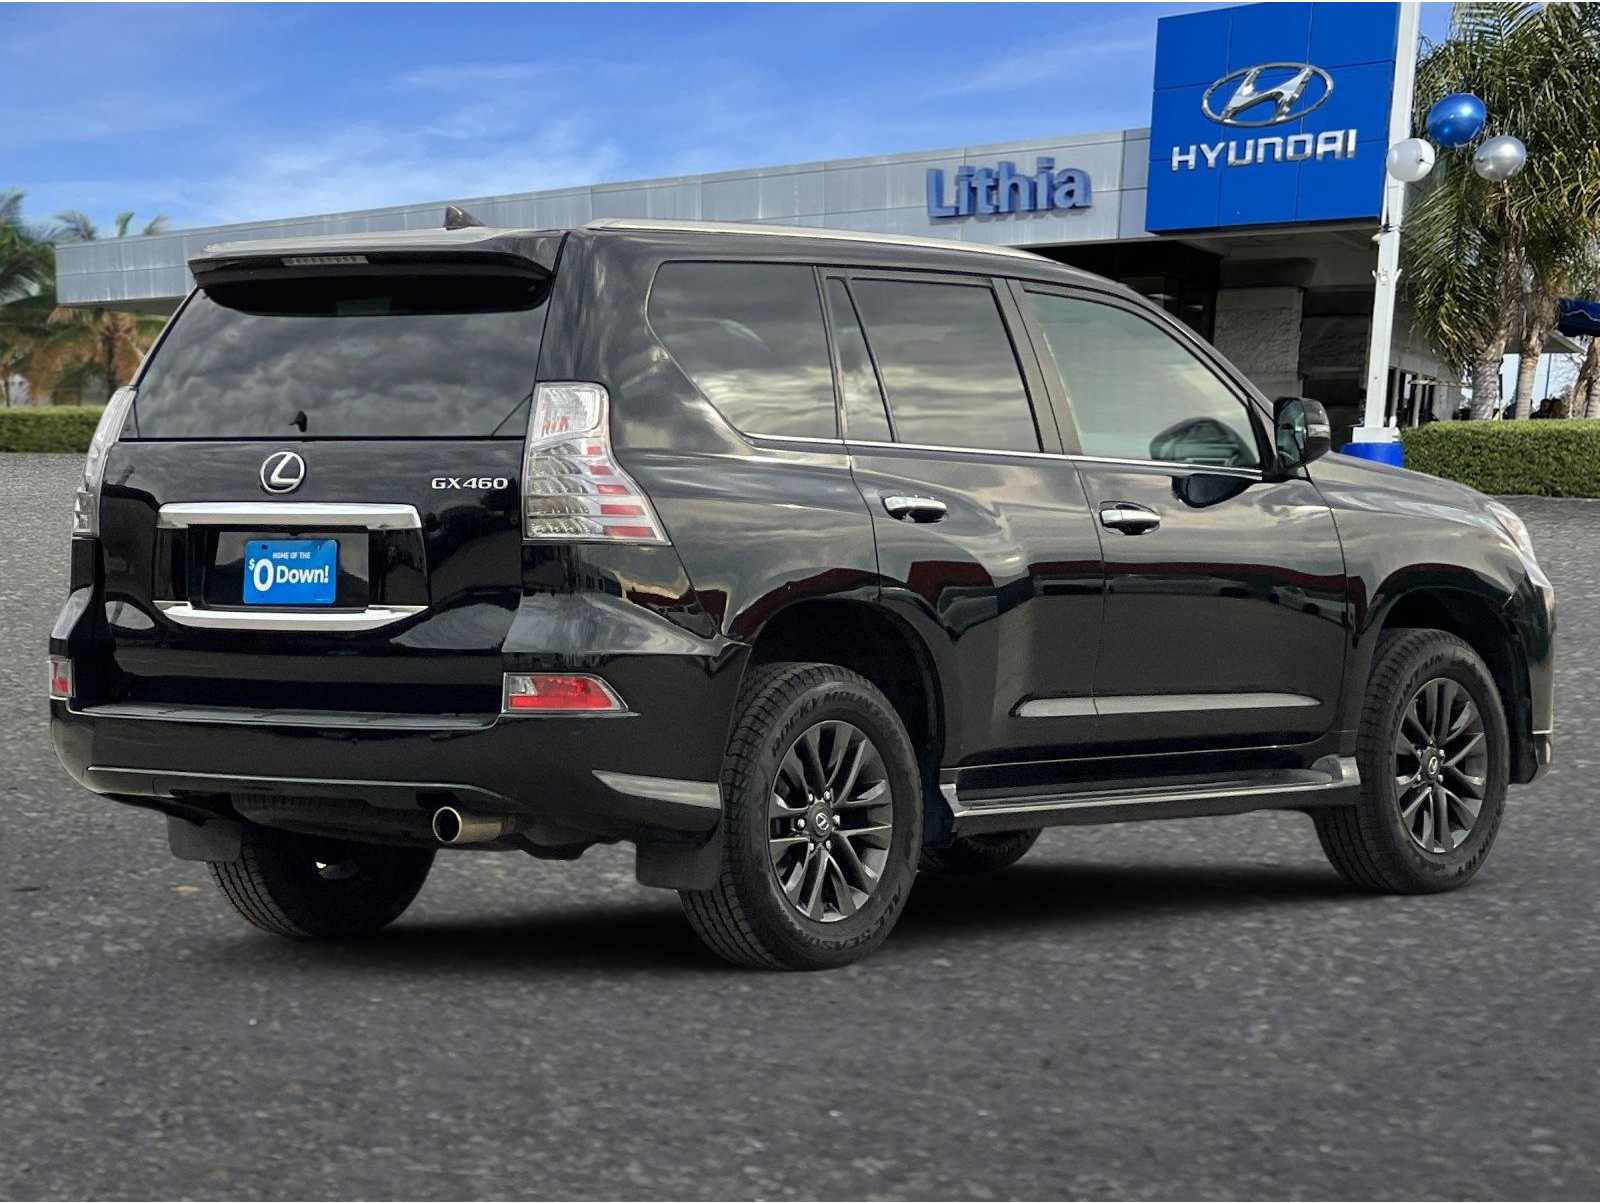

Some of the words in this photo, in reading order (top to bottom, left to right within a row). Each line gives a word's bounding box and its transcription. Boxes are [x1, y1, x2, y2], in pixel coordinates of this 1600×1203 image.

[1171, 129, 1357, 171] HYUNDAI
[927, 156, 1092, 217] Lithia
[272, 551, 289, 560] HOME
[289, 551, 298, 560] OF
[299, 551, 311, 560] THE
[275, 565, 329, 584] Down!
